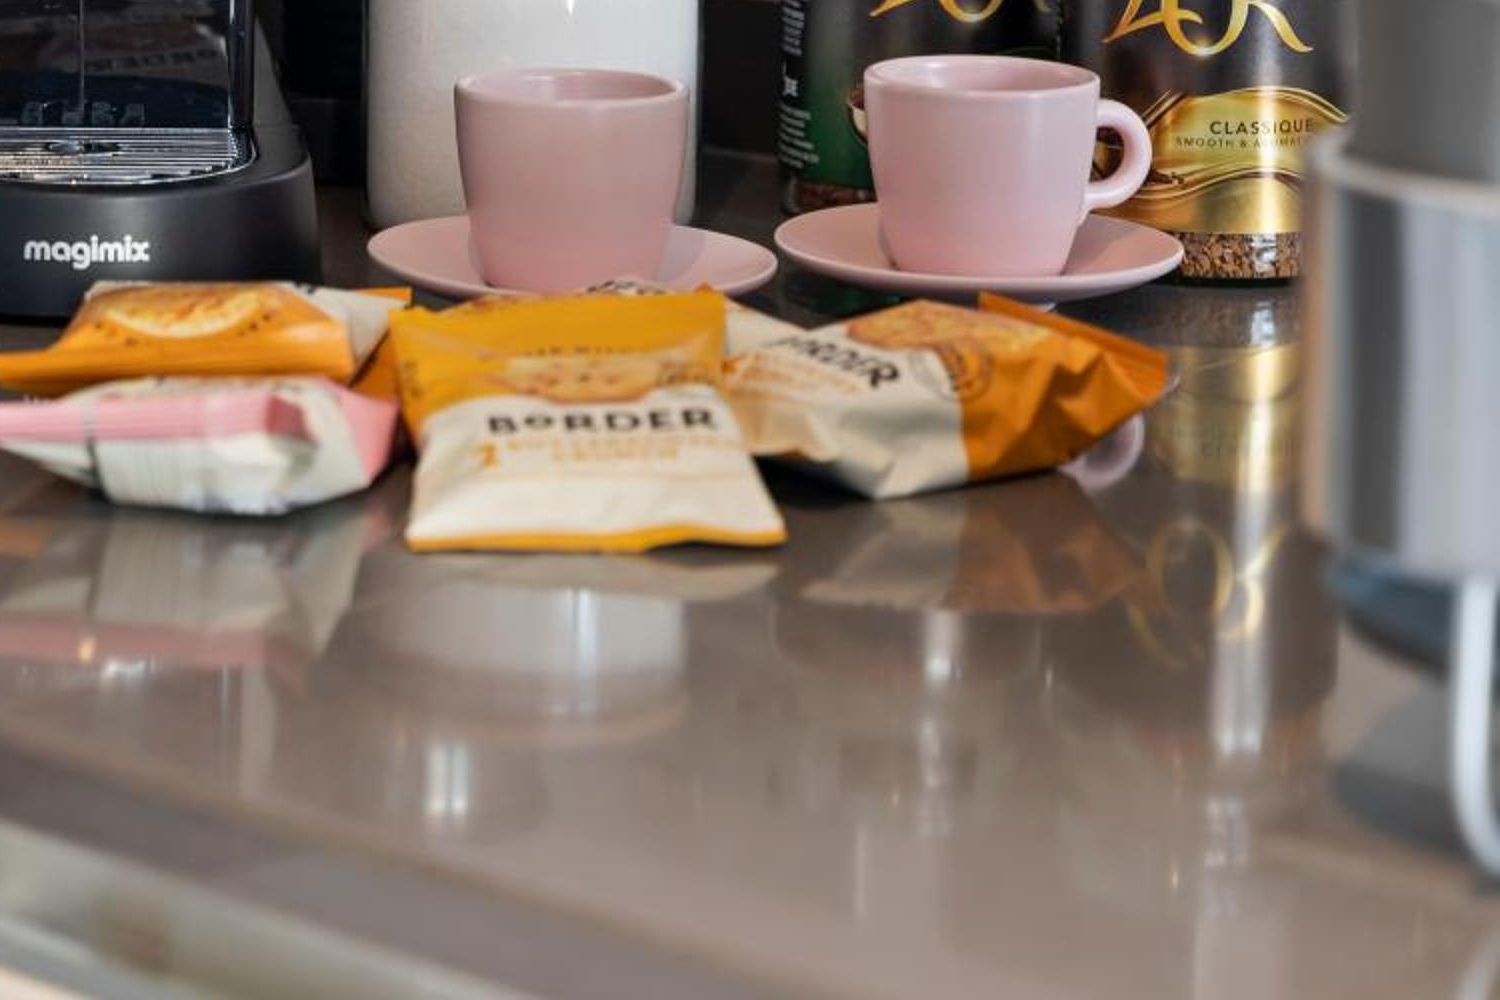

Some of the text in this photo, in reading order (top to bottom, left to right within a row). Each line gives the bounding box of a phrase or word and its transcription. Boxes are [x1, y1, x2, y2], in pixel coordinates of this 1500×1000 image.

[1175, 135, 1236, 149] SMOOTH
[1239, 137, 1247, 148] &
[23, 234, 150, 270] magimix
[487, 406, 718, 434] BORDER
